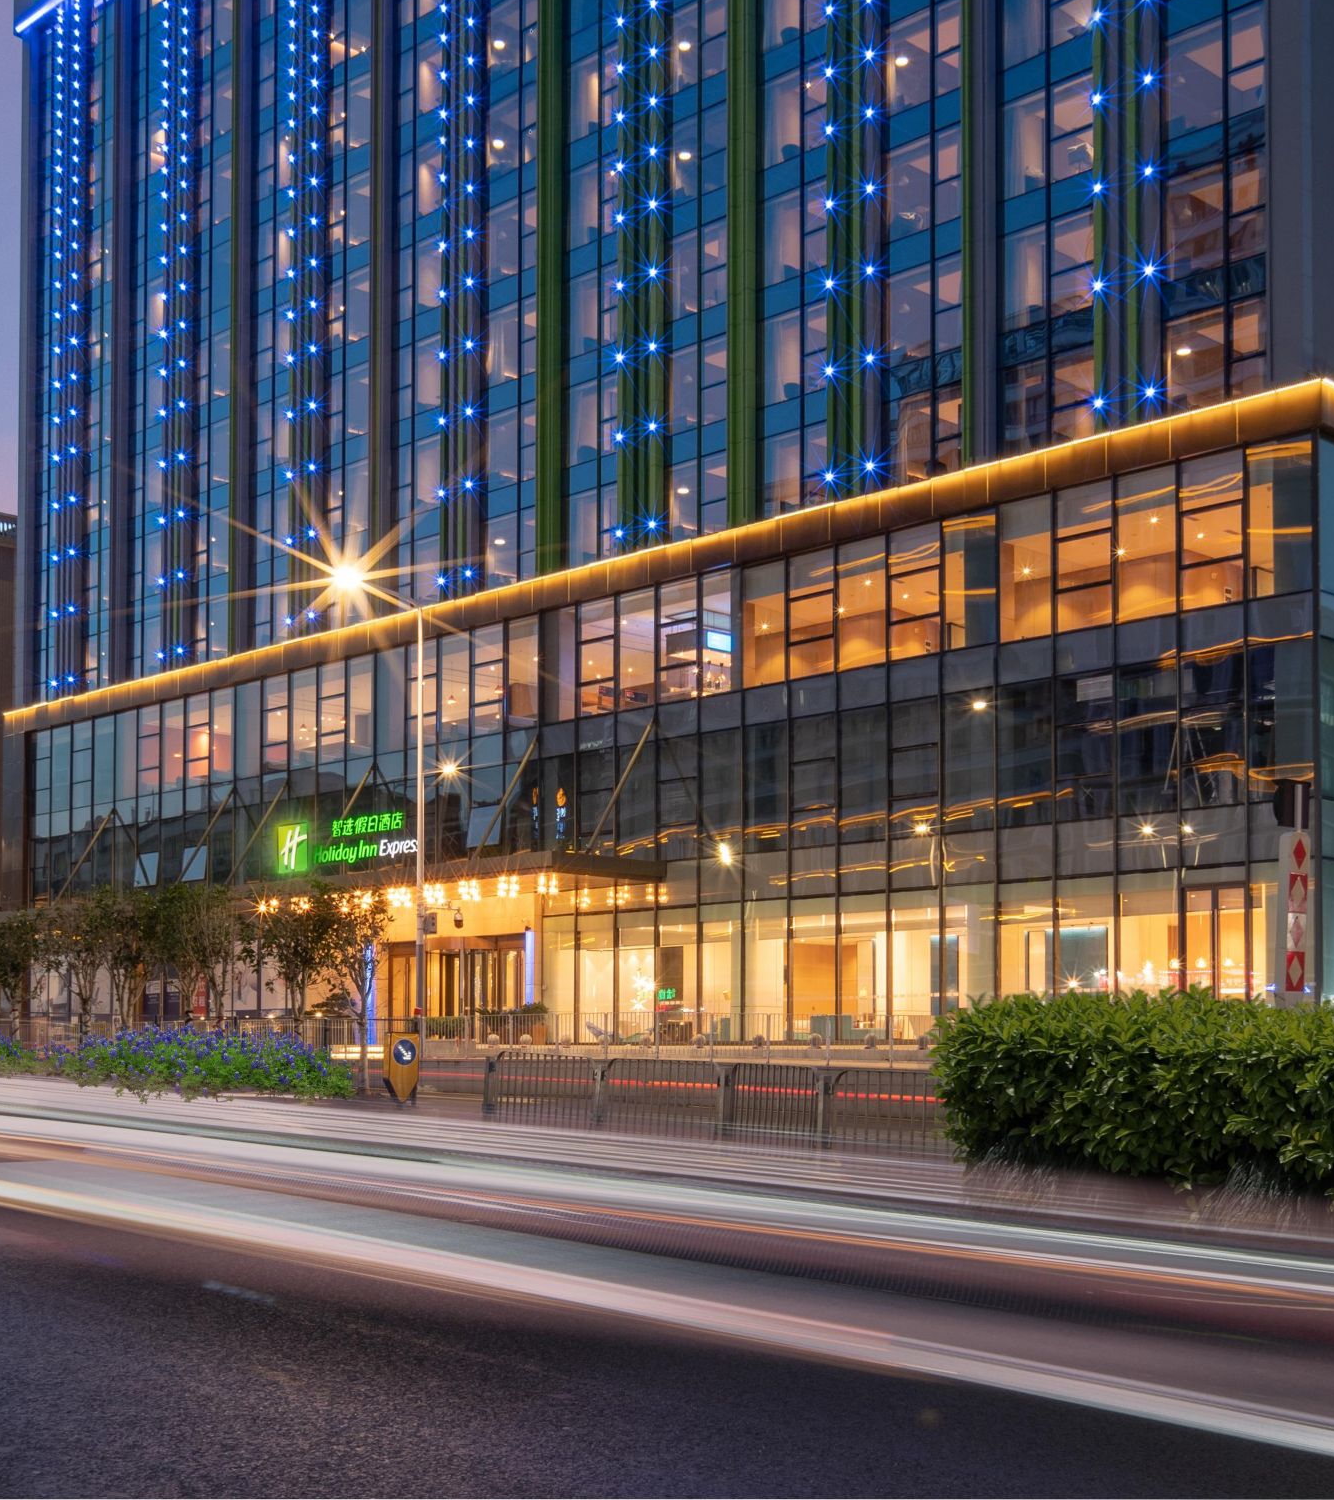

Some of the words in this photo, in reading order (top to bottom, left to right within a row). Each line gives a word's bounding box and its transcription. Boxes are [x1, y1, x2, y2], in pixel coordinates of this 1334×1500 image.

[331, 812, 403, 838] 智选假日酒店
[314, 842, 358, 864] Holiday
[358, 840, 378, 858] Inn
[379, 839, 418, 858] Expres
